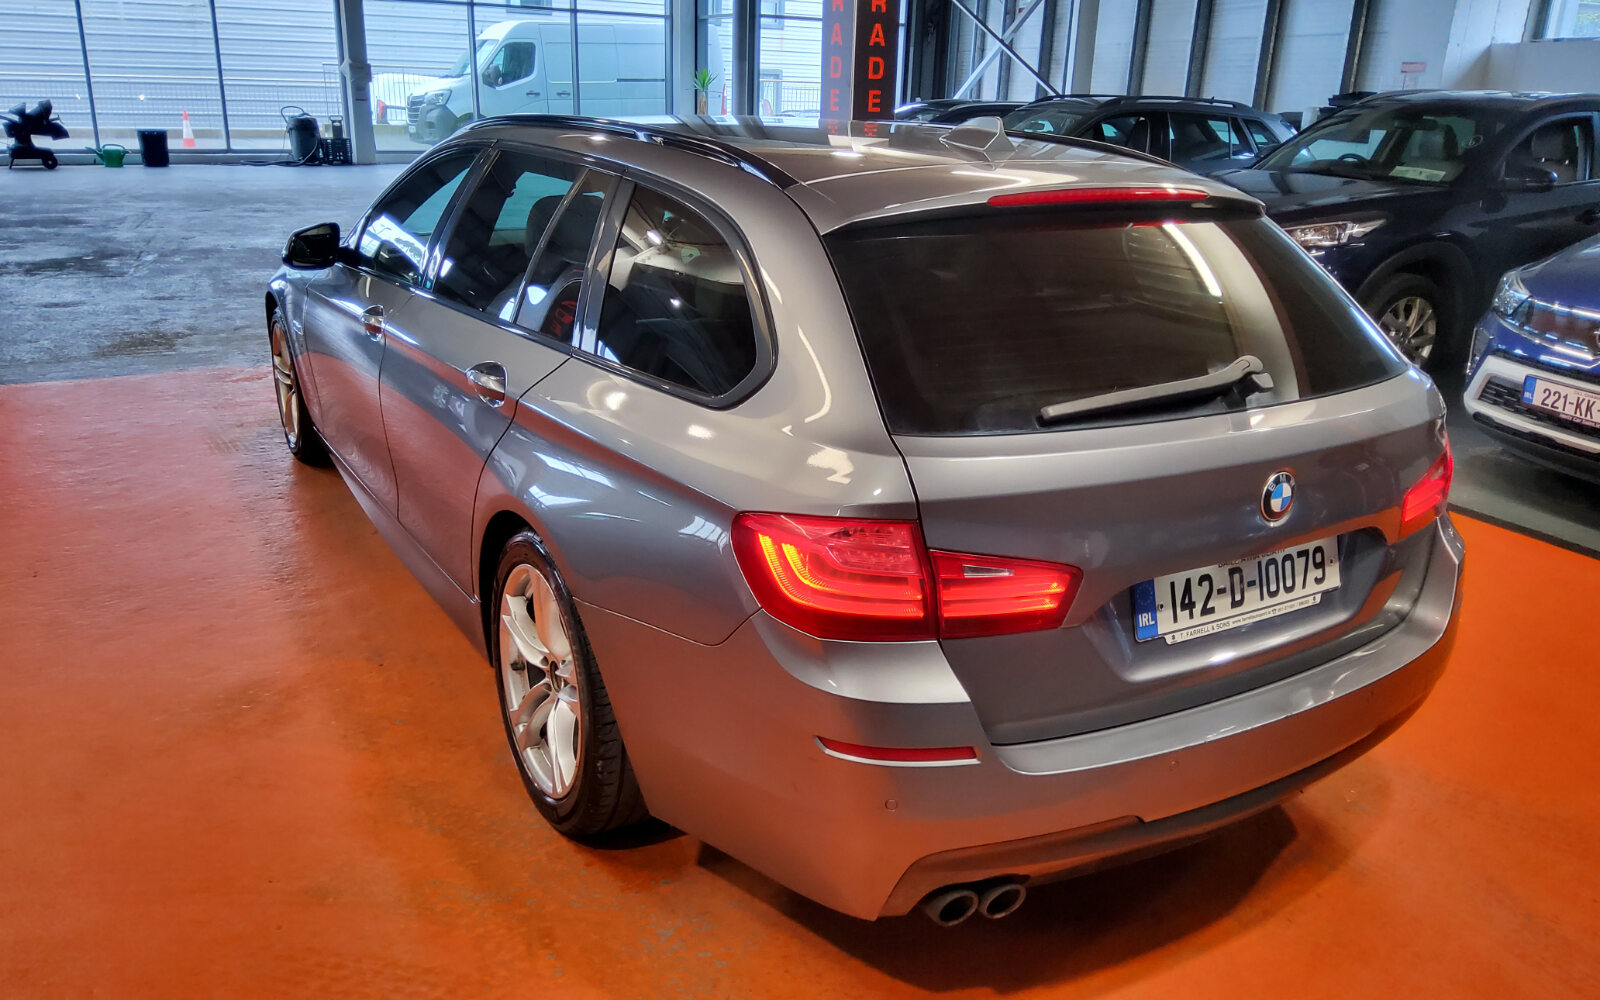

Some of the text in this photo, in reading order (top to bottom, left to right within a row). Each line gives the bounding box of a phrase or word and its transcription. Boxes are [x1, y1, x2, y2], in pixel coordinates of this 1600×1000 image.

[1170, 545, 1326, 624] 142-D-10079
[1138, 613, 1155, 628] IRL
[1186, 626, 1211, 637] FARRELL
[1216, 621, 1230, 630] SONS
